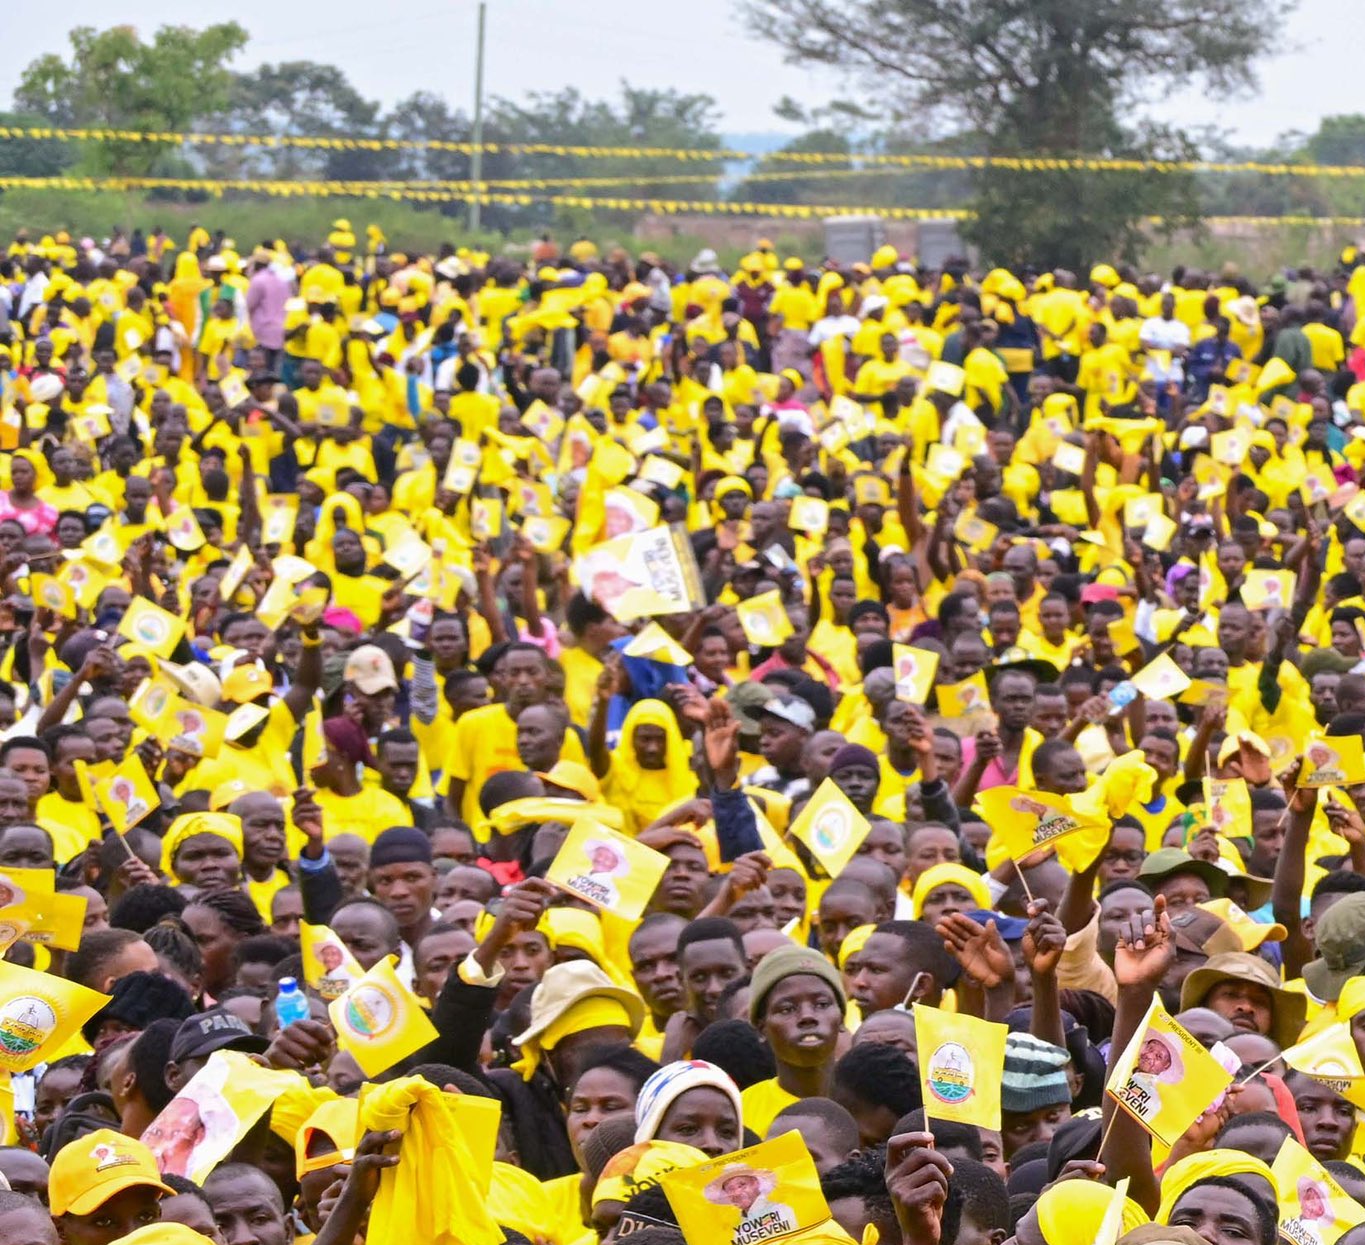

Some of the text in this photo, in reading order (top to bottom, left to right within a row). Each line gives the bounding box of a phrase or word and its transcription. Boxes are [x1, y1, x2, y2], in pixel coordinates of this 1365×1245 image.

[1031, 823, 1077, 845] MUSEVENI
[1167, 1020, 1198, 1049] PRESIDENT
[1125, 1077, 1152, 1103] WERI
[733, 1210, 780, 1235] YOWERI
